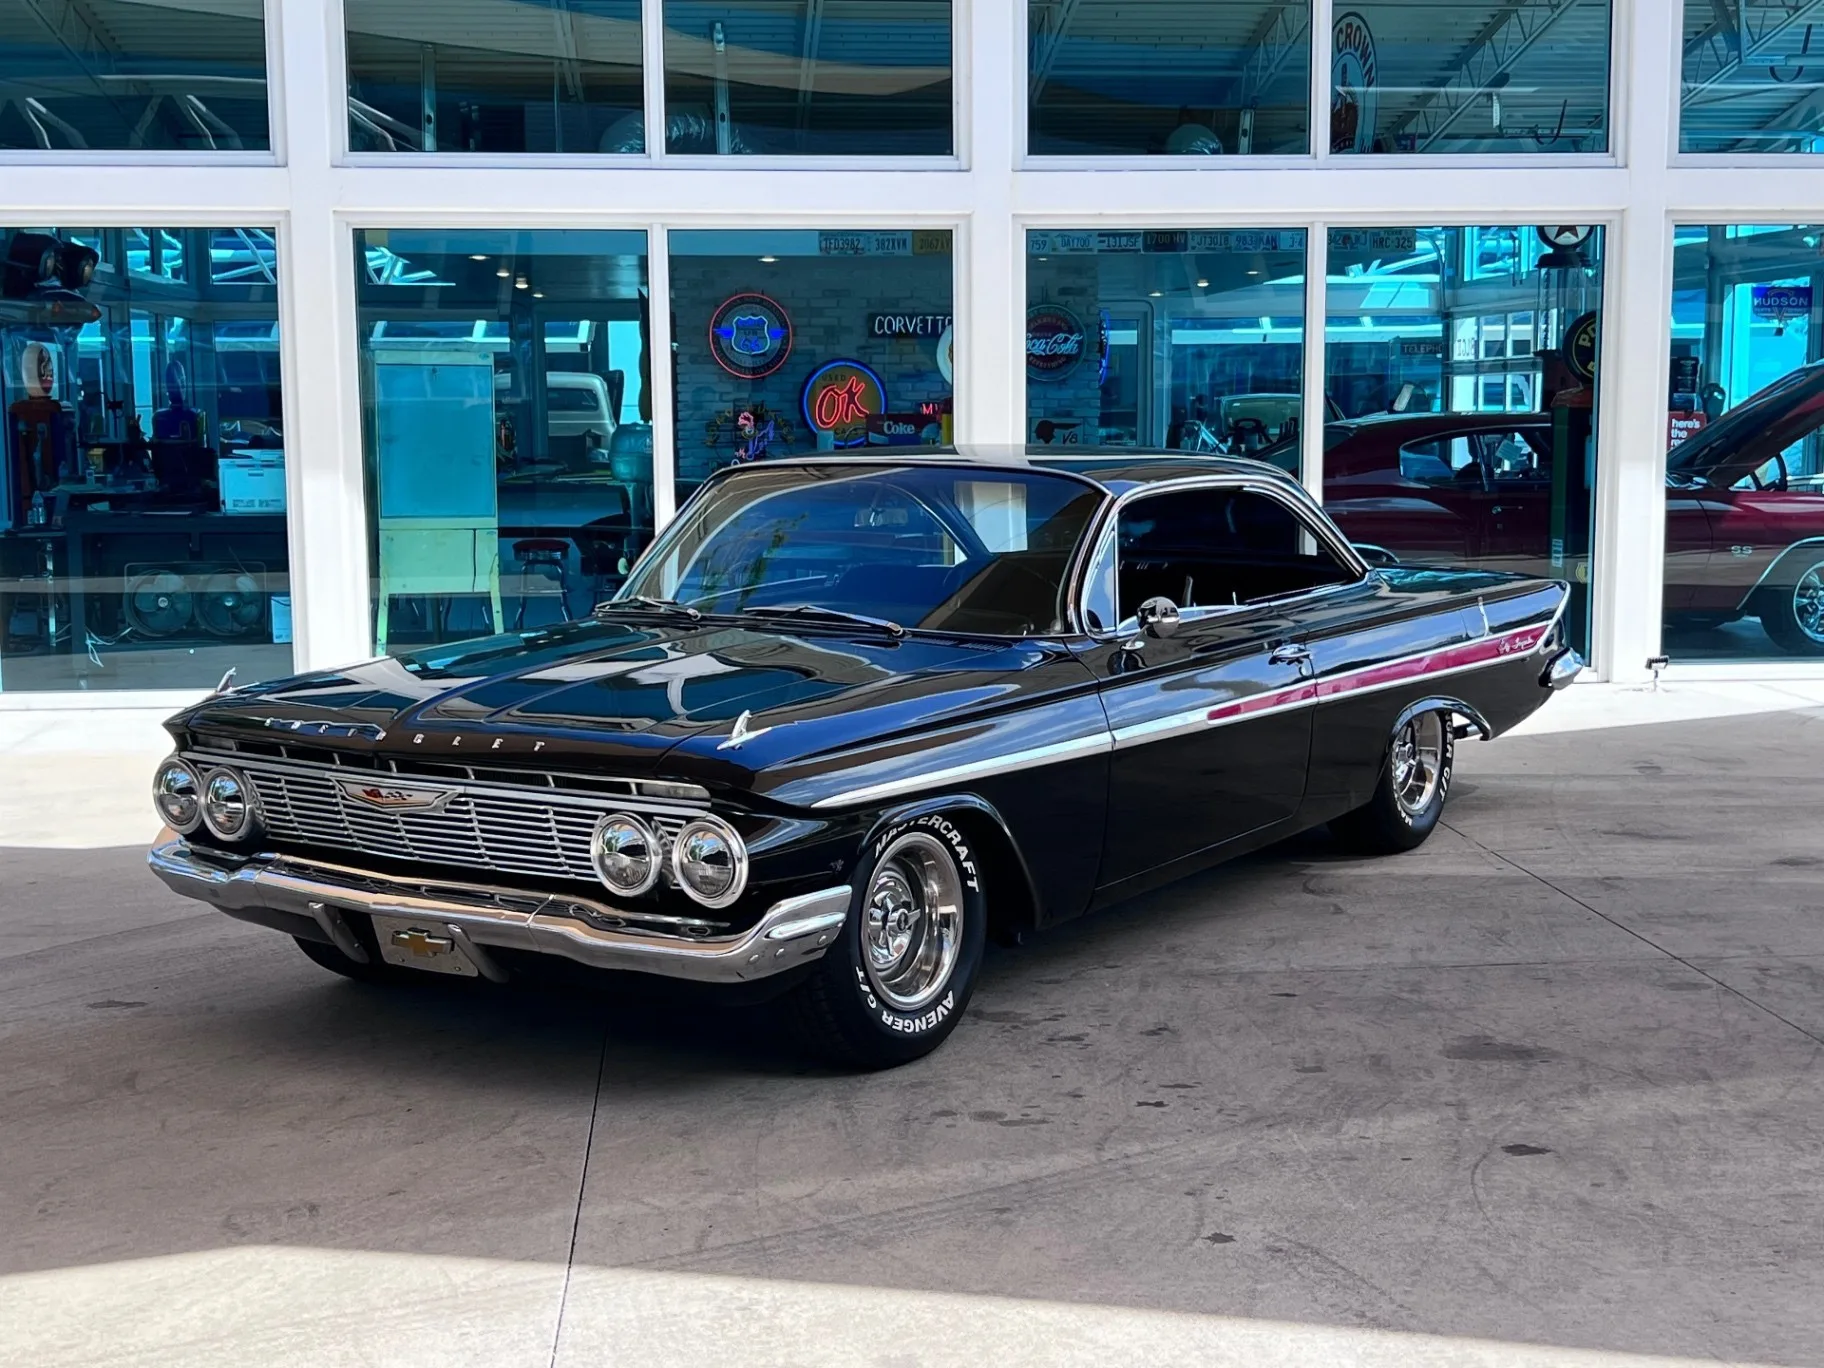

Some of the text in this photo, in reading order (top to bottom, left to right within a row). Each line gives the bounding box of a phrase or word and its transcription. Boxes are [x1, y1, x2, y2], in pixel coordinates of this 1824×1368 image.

[1336, 22, 1375, 88] CROWN
[1754, 297, 1808, 306] HUDSON
[1026, 333, 1083, 356] oca-Cola
[816, 376, 870, 428] OK
[883, 421, 916, 435] Coke
[1671, 418, 1701, 429] here's
[1671, 428, 1688, 439] the
[1731, 545, 1753, 554] SS
[881, 990, 955, 1033] AVENGER
